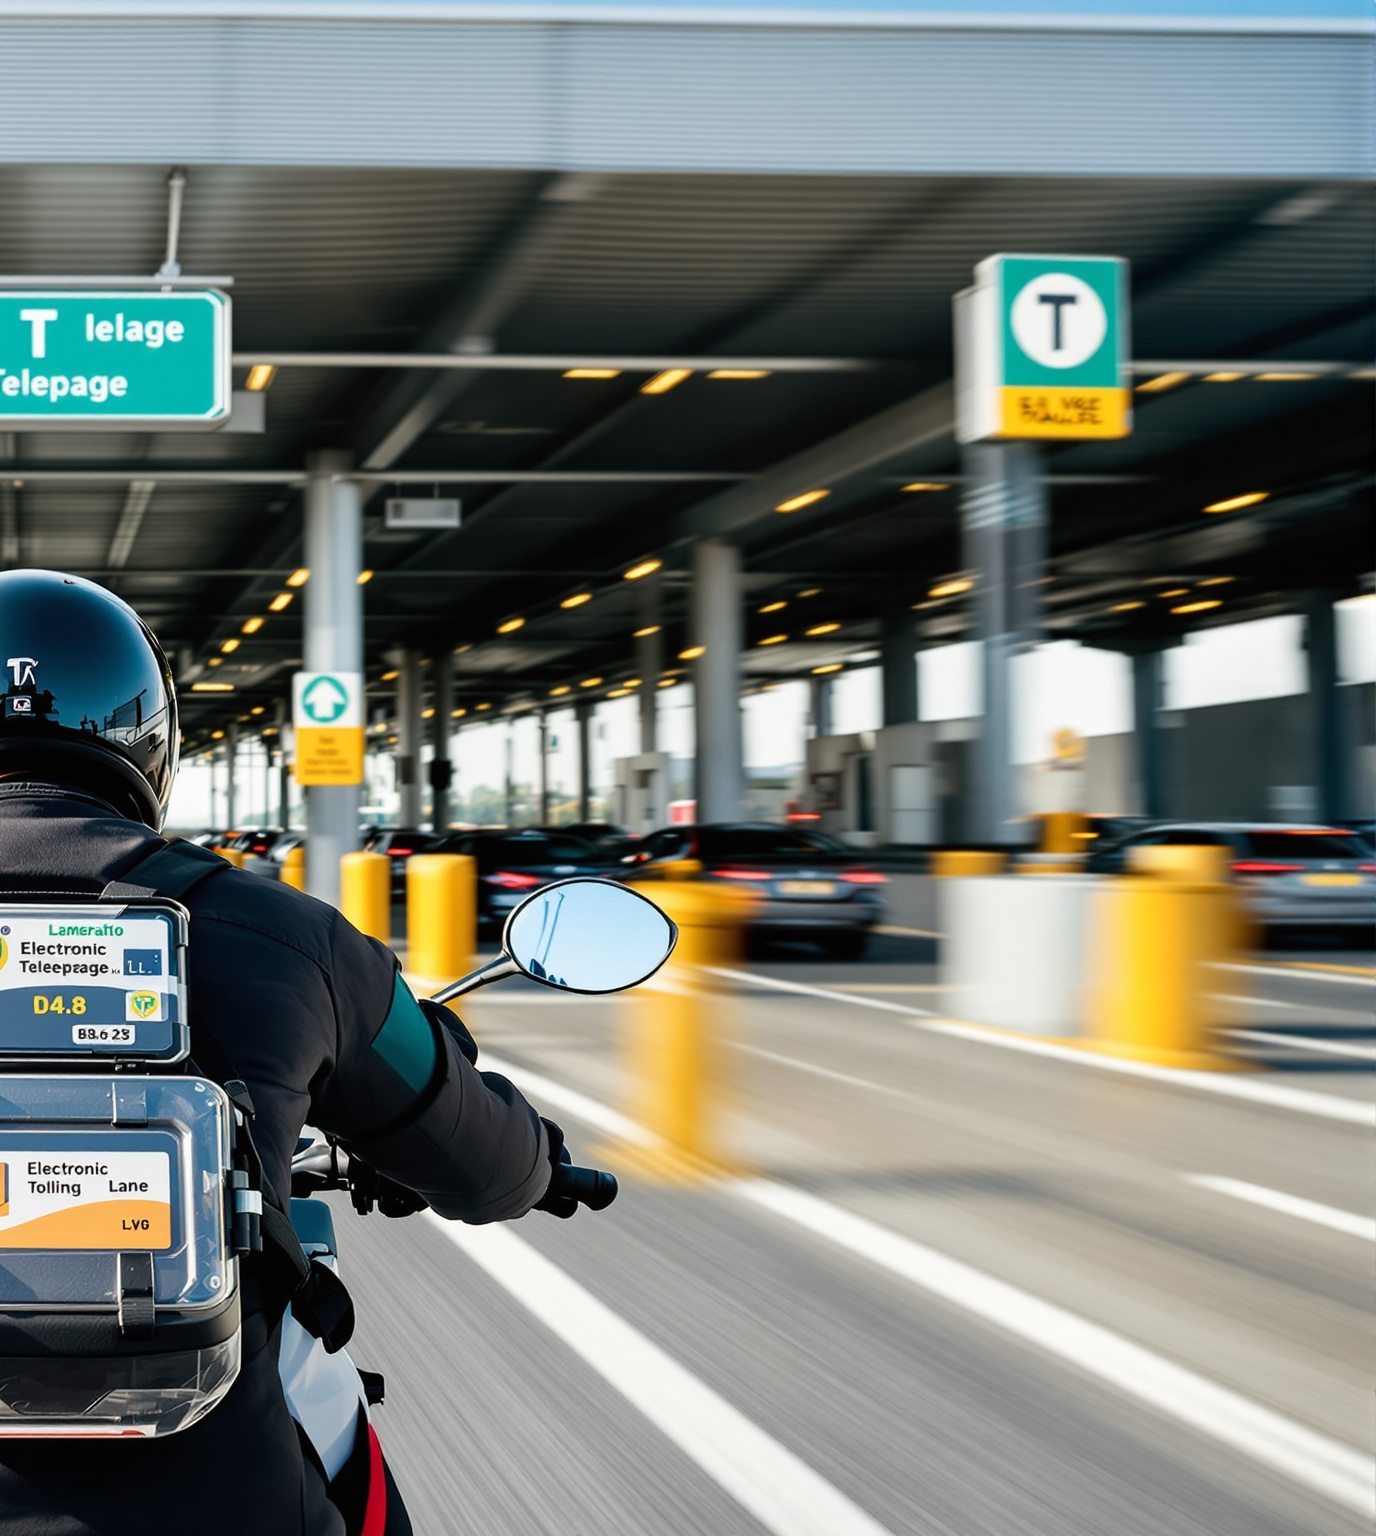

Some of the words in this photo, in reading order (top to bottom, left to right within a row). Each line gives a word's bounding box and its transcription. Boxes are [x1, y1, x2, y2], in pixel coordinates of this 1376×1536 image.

[1038, 294, 1078, 351] T
[20, 309, 58, 358] T
[20, 941, 107, 956] Electronic
[33, 995, 87, 1015] D4.8
[27, 1161, 109, 1176] Electronic
[28, 1181, 82, 1197] Tolling
[108, 1180, 149, 1193] Lane
